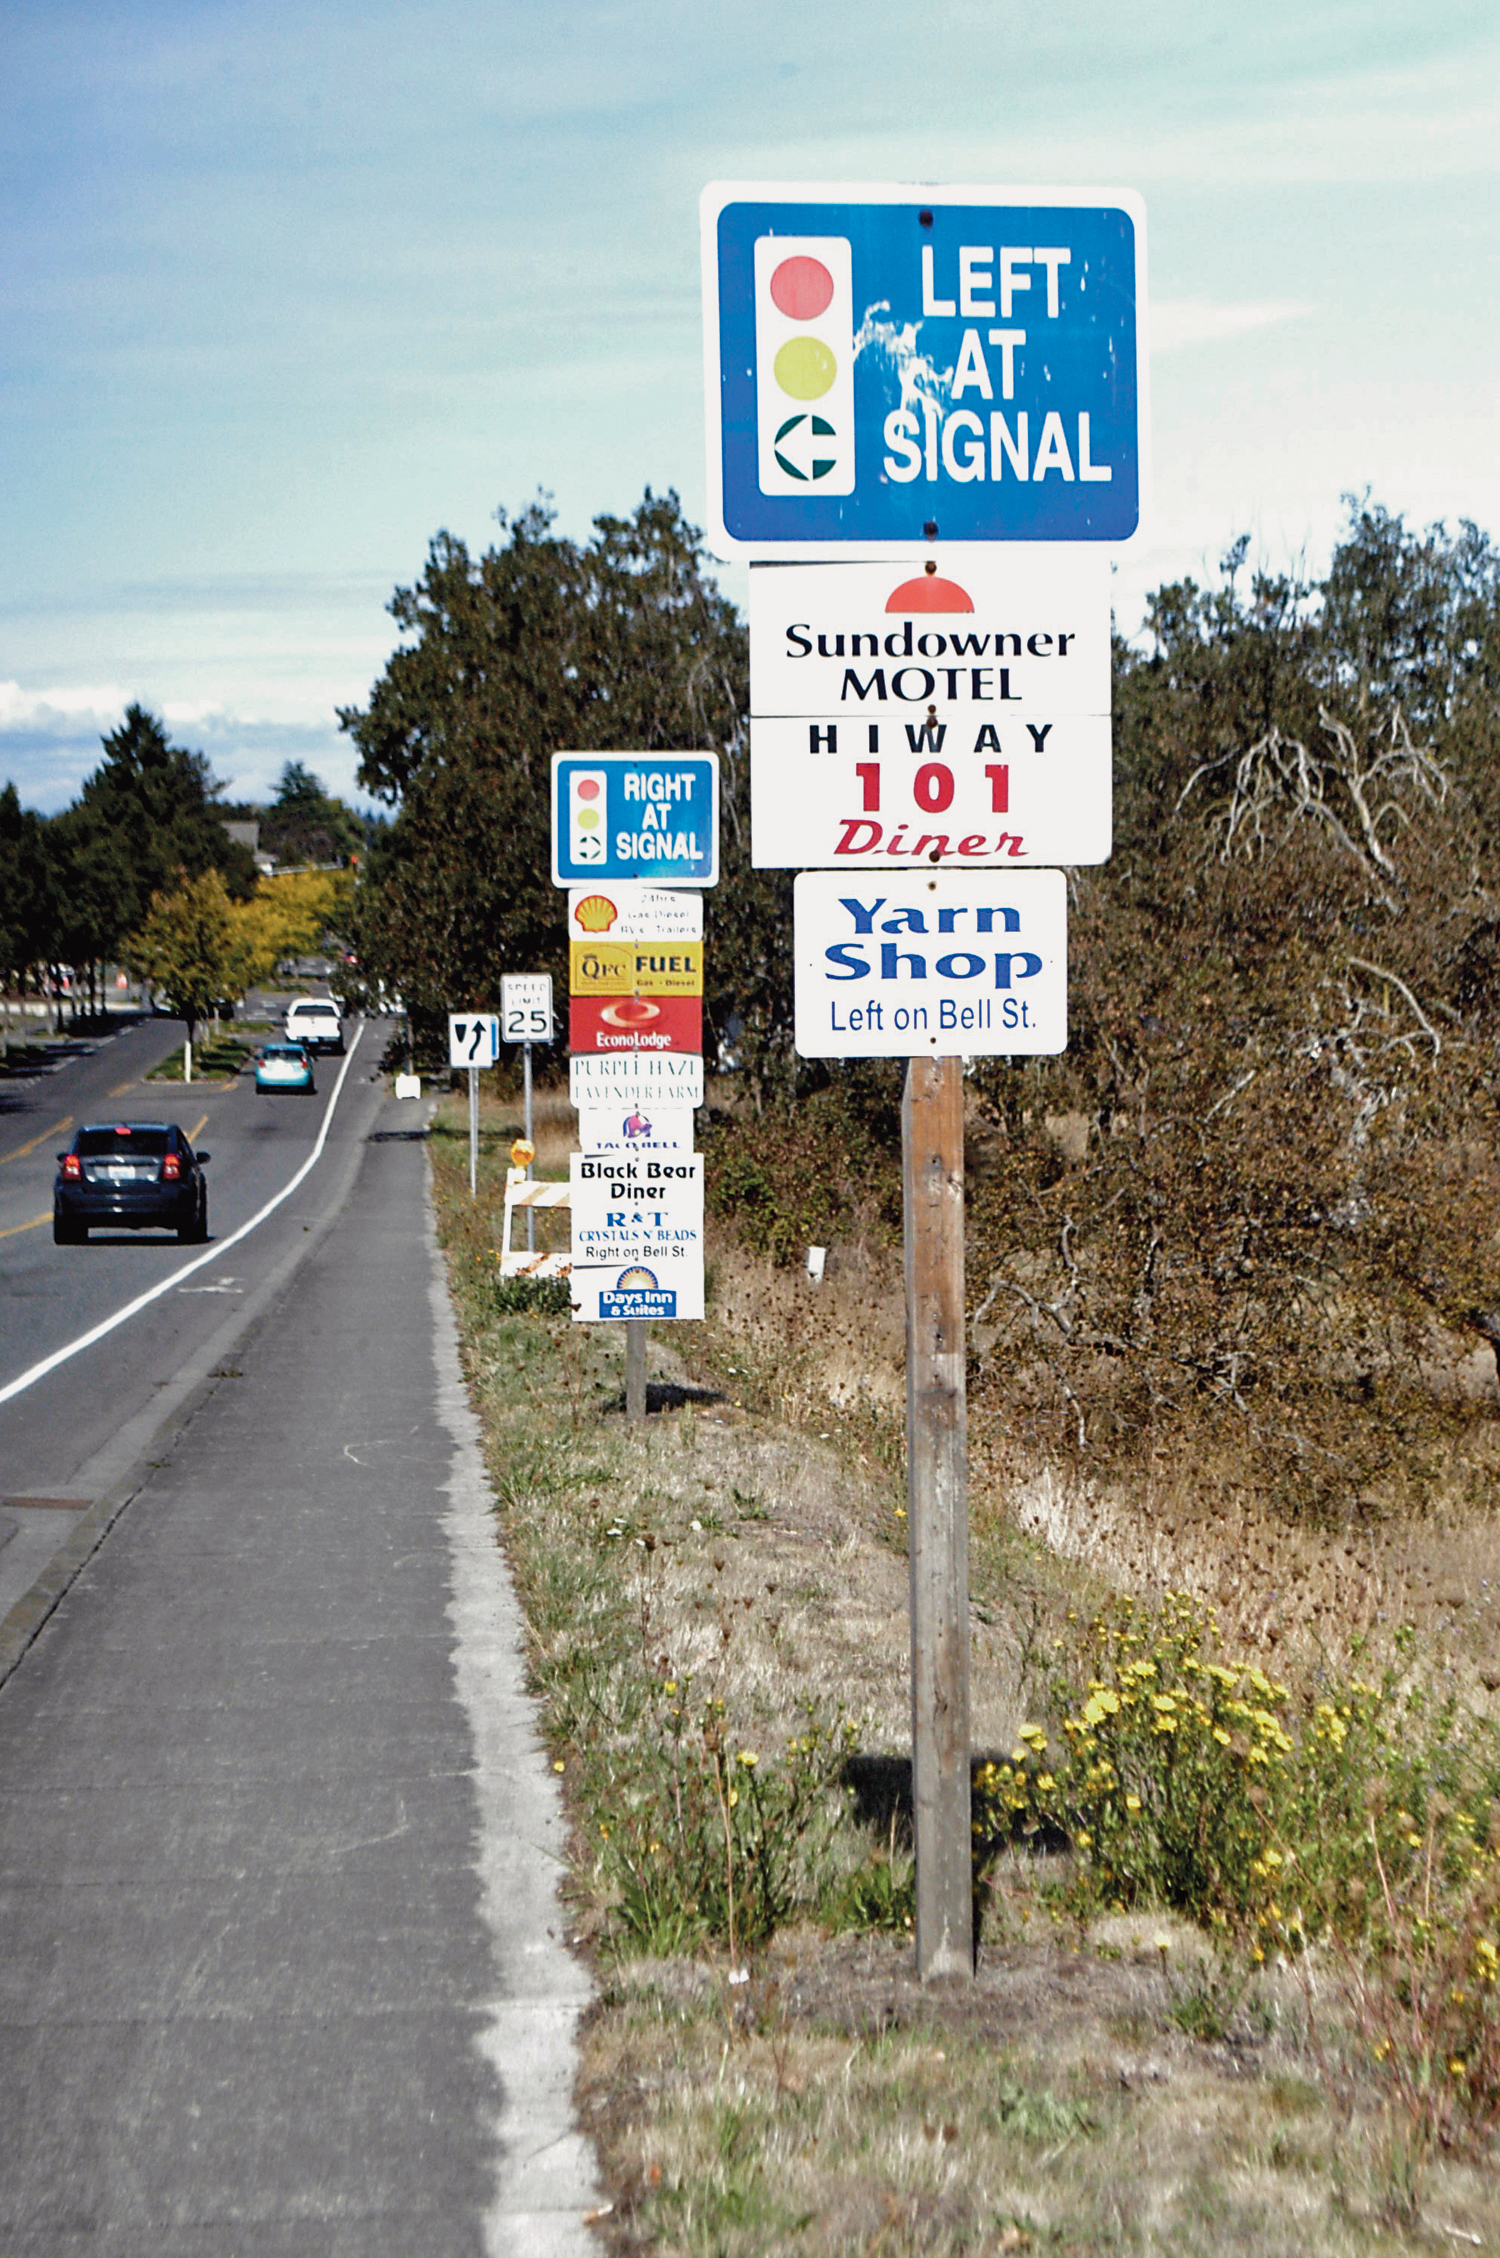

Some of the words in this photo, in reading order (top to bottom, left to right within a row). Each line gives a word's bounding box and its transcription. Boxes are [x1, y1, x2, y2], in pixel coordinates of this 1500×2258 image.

[921, 245, 1071, 318] LEFT
[950, 328, 1027, 400] AT
[883, 409, 1112, 483] SIGNAL
[786, 621, 1075, 658] Sundowner
[841, 667, 1022, 701] MOTEL
[809, 724, 1053, 754] HIWAY
[624, 773, 696, 801] RIGHT
[855, 762, 1009, 813] 101
[642, 803, 672, 830] AT
[616, 832, 704, 860] SIGNAL
[833, 819, 1030, 857] Diner
[838, 898, 1021, 934] Yarn
[581, 959, 626, 979] QFC
[635, 956, 697, 973] FUEL
[824, 943, 1042, 989] Shop
[507, 983, 547, 992] SPEED
[636, 979, 654, 987] Gas
[665, 979, 695, 987] Diesel
[511, 997, 541, 1006] LIMIT
[508, 1010, 547, 1033] 25
[831, 1000, 883, 1031] Left
[894, 1007, 928, 1030] on
[939, 999, 990, 1029] Bell
[1002, 998, 1036, 1028] St.
[596, 1031, 672, 1049] EconoLodge
[575, 1060, 640, 1076] PURPLE
[641, 1141, 681, 1149] BELL
[581, 1162, 638, 1178] Black
[647, 1162, 696, 1178] Bear
[611, 1183, 666, 1199] Diner
[579, 1230, 639, 1242] CRYSTALS
[657, 1230, 697, 1241] BEADS
[586, 1246, 620, 1260] Right
[623, 1248, 639, 1257] on
[643, 1246, 668, 1257] Bell
[672, 1246, 688, 1257] St.
[603, 1291, 643, 1306] Days
[645, 1291, 673, 1303] Inn
[611, 1306, 622, 1316] &
[624, 1304, 665, 1316] Suites
